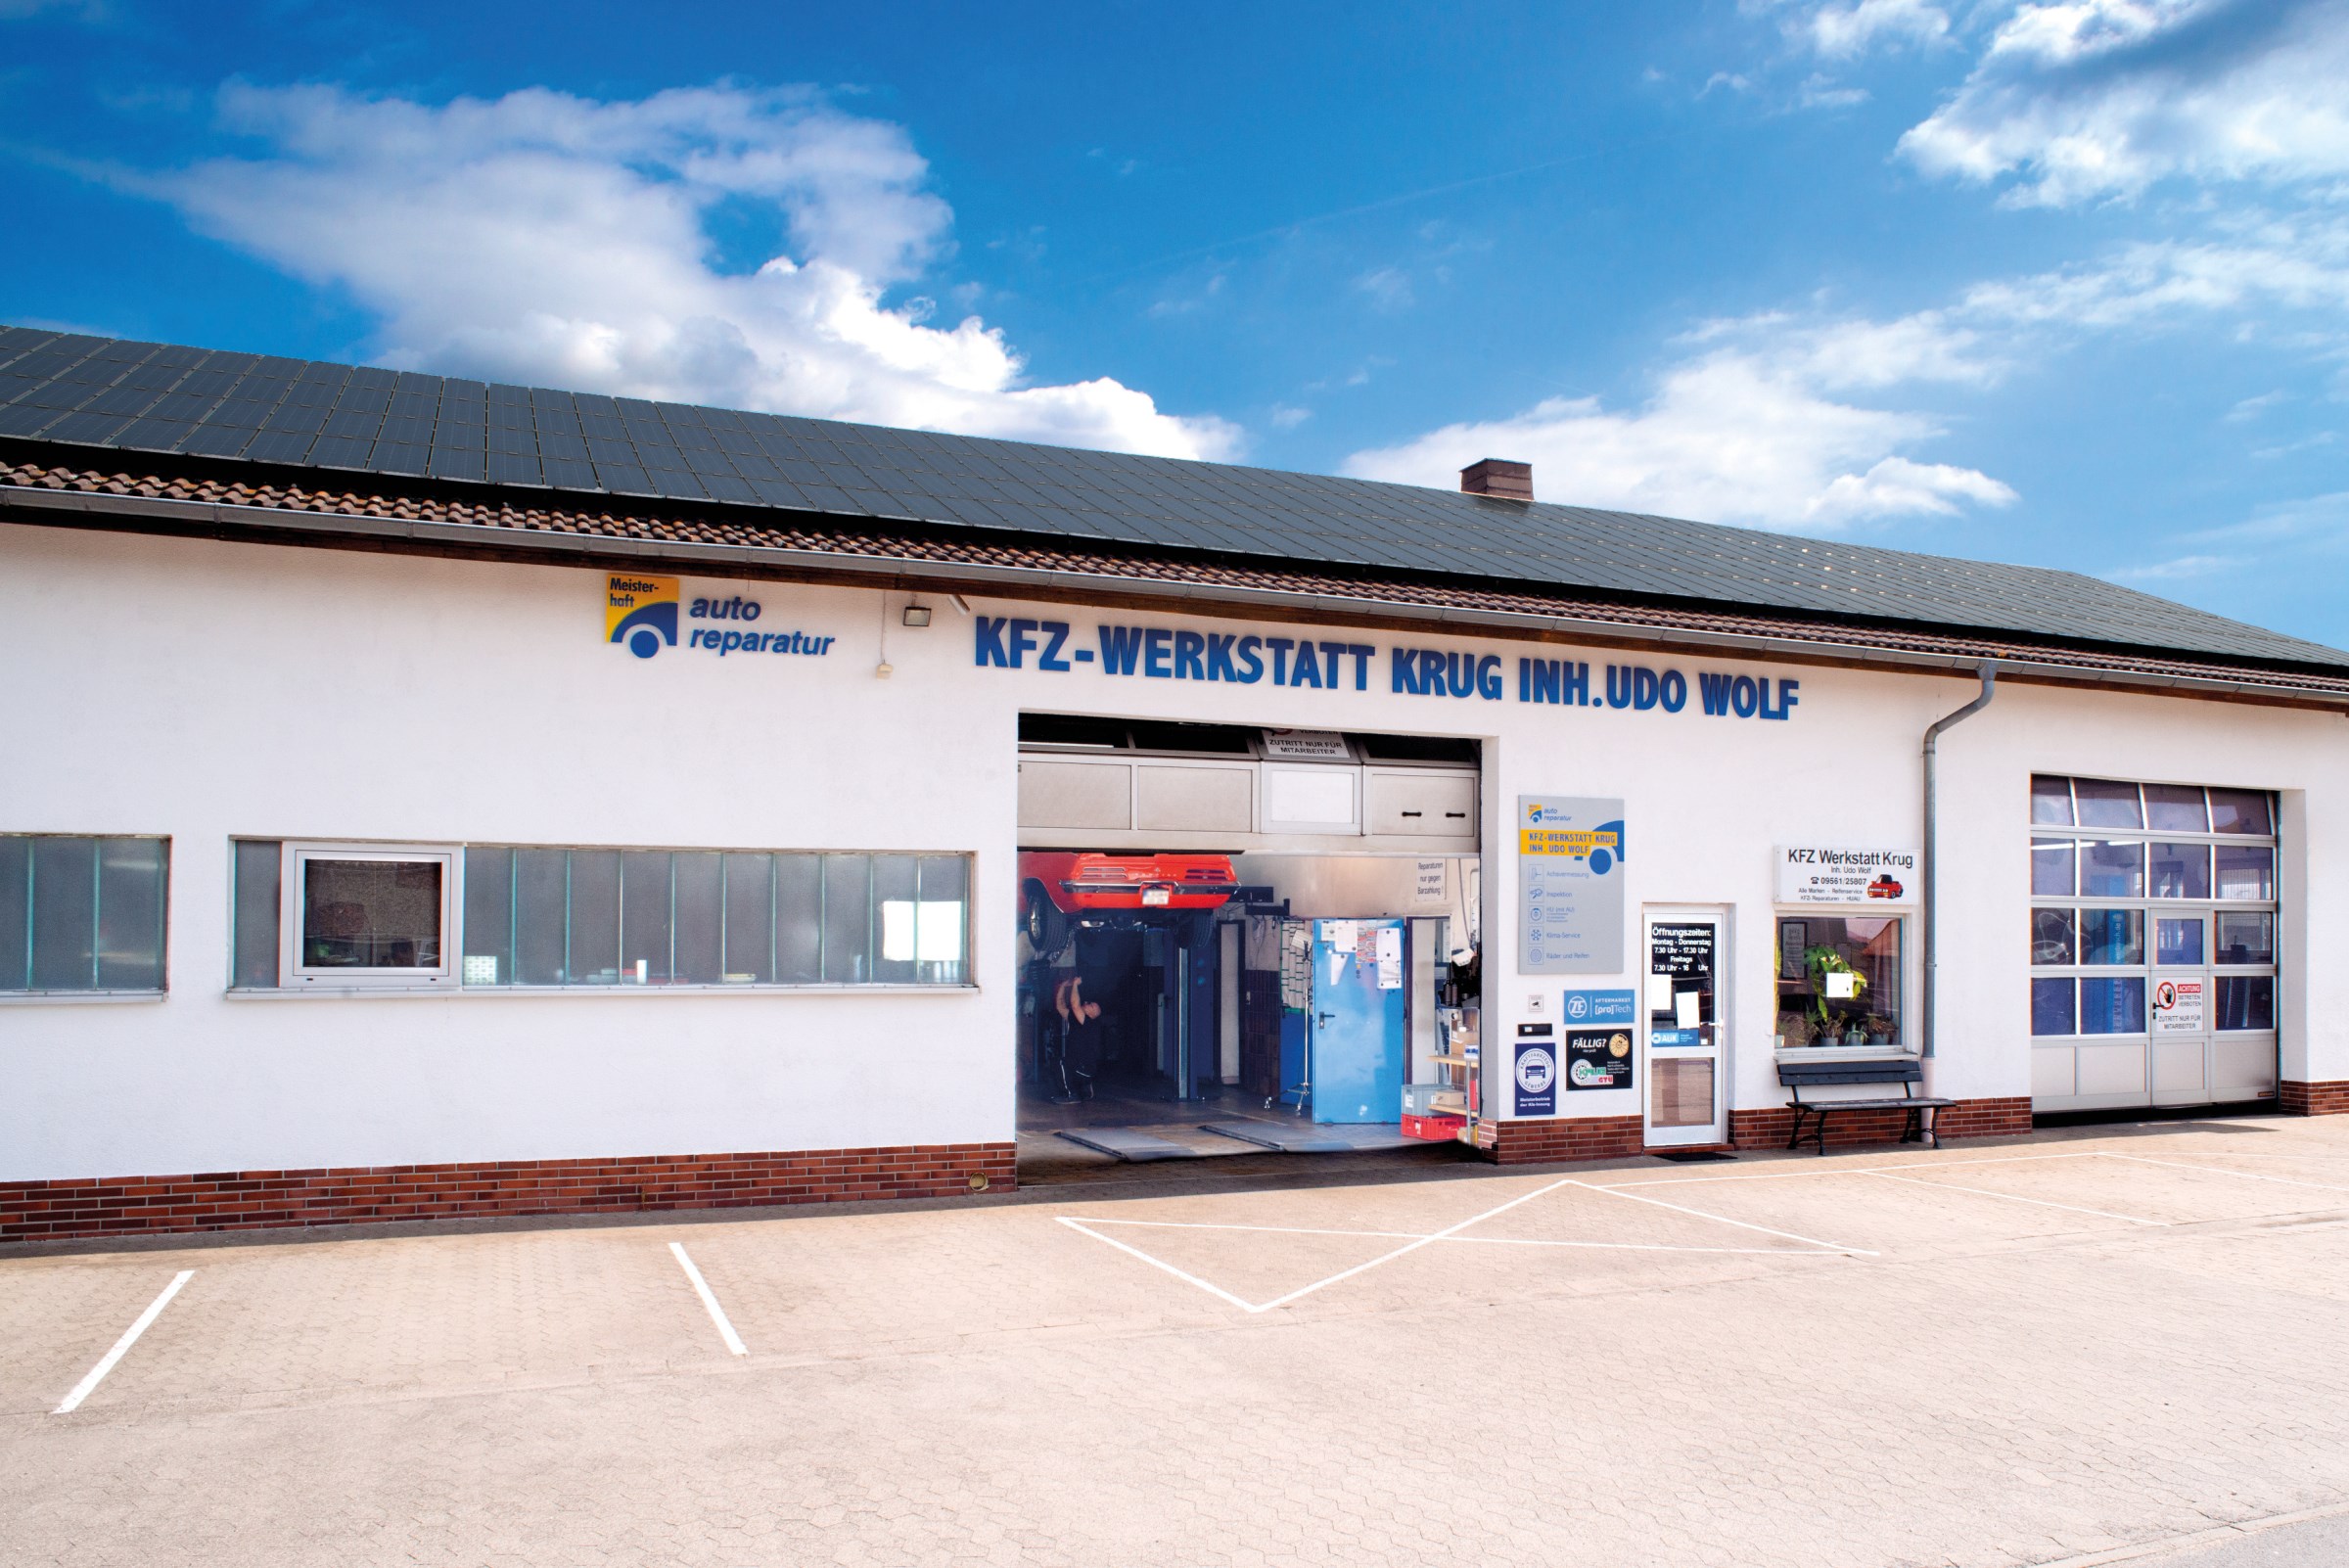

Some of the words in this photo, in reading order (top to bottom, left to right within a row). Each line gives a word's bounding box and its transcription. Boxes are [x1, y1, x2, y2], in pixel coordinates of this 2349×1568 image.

[610, 577, 659, 592] Meister-
[610, 593, 634, 608] haft
[689, 596, 761, 622] auto
[689, 628, 835, 657] reparatur
[975, 616, 1376, 691] KFZ-WERKSTATT
[1392, 647, 1502, 701] KRUG
[1699, 671, 1800, 721] WOLF
[1529, 832, 1593, 843] KFZ-WERKSTATT
[1595, 833, 1616, 844] KRUG
[1548, 844, 1566, 853] UDO
[1568, 846, 1589, 854] WOLF
[1788, 849, 1815, 863] KFZ
[1819, 850, 1880, 865] Werkstatt
[1882, 852, 1913, 869] Krug
[1652, 926, 1711, 938] Öffnungszeiten:
[1569, 999, 1586, 1015] ZF
[1573, 1038, 1607, 1048] FÄLLIG?
